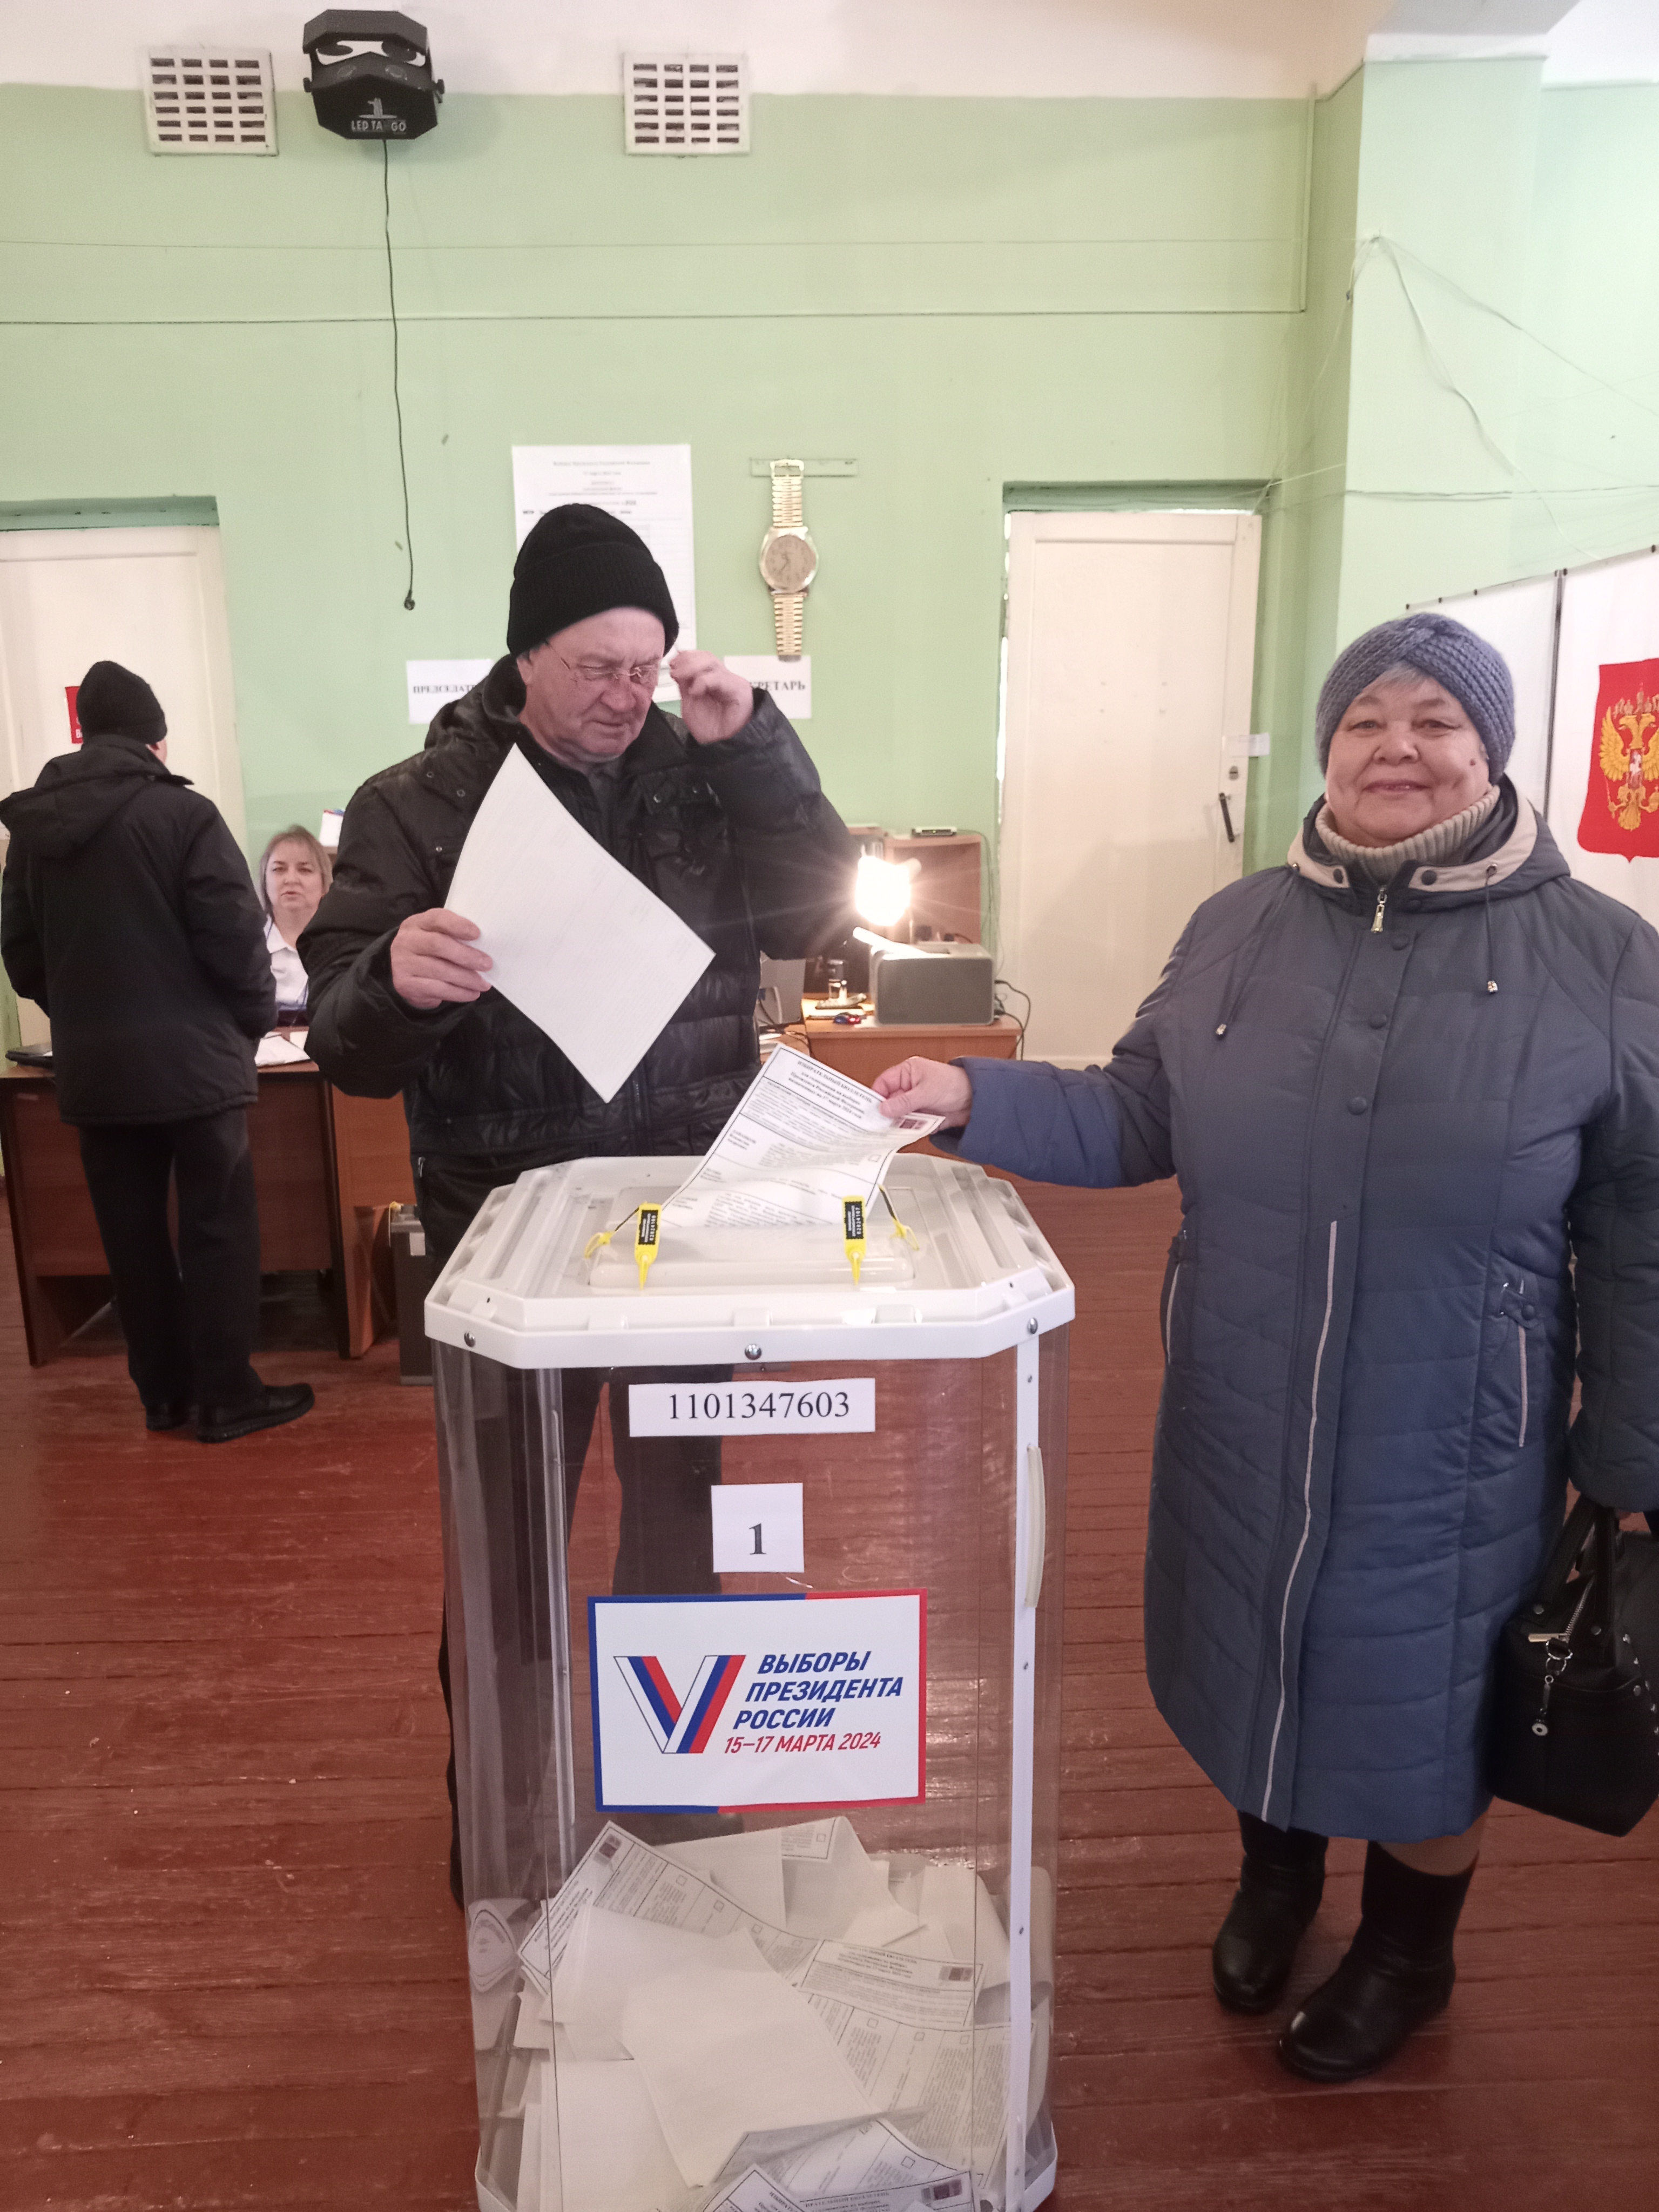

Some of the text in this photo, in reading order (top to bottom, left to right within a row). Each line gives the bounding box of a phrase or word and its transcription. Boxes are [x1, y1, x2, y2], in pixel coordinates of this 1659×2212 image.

[351, 120, 369, 131] LED
[669, 1392, 849, 1420] 1101347603
[748, 1523, 766, 1555] 1
[757, 1651, 872, 1674] ВЫБОРЫ
[745, 1677, 903, 1703] ПРЕЗИДЕНТА
[732, 1708, 836, 1730] РОССИИ
[774, 1734, 836, 1753] МАРТА
[838, 1731, 881, 1751] 2024
